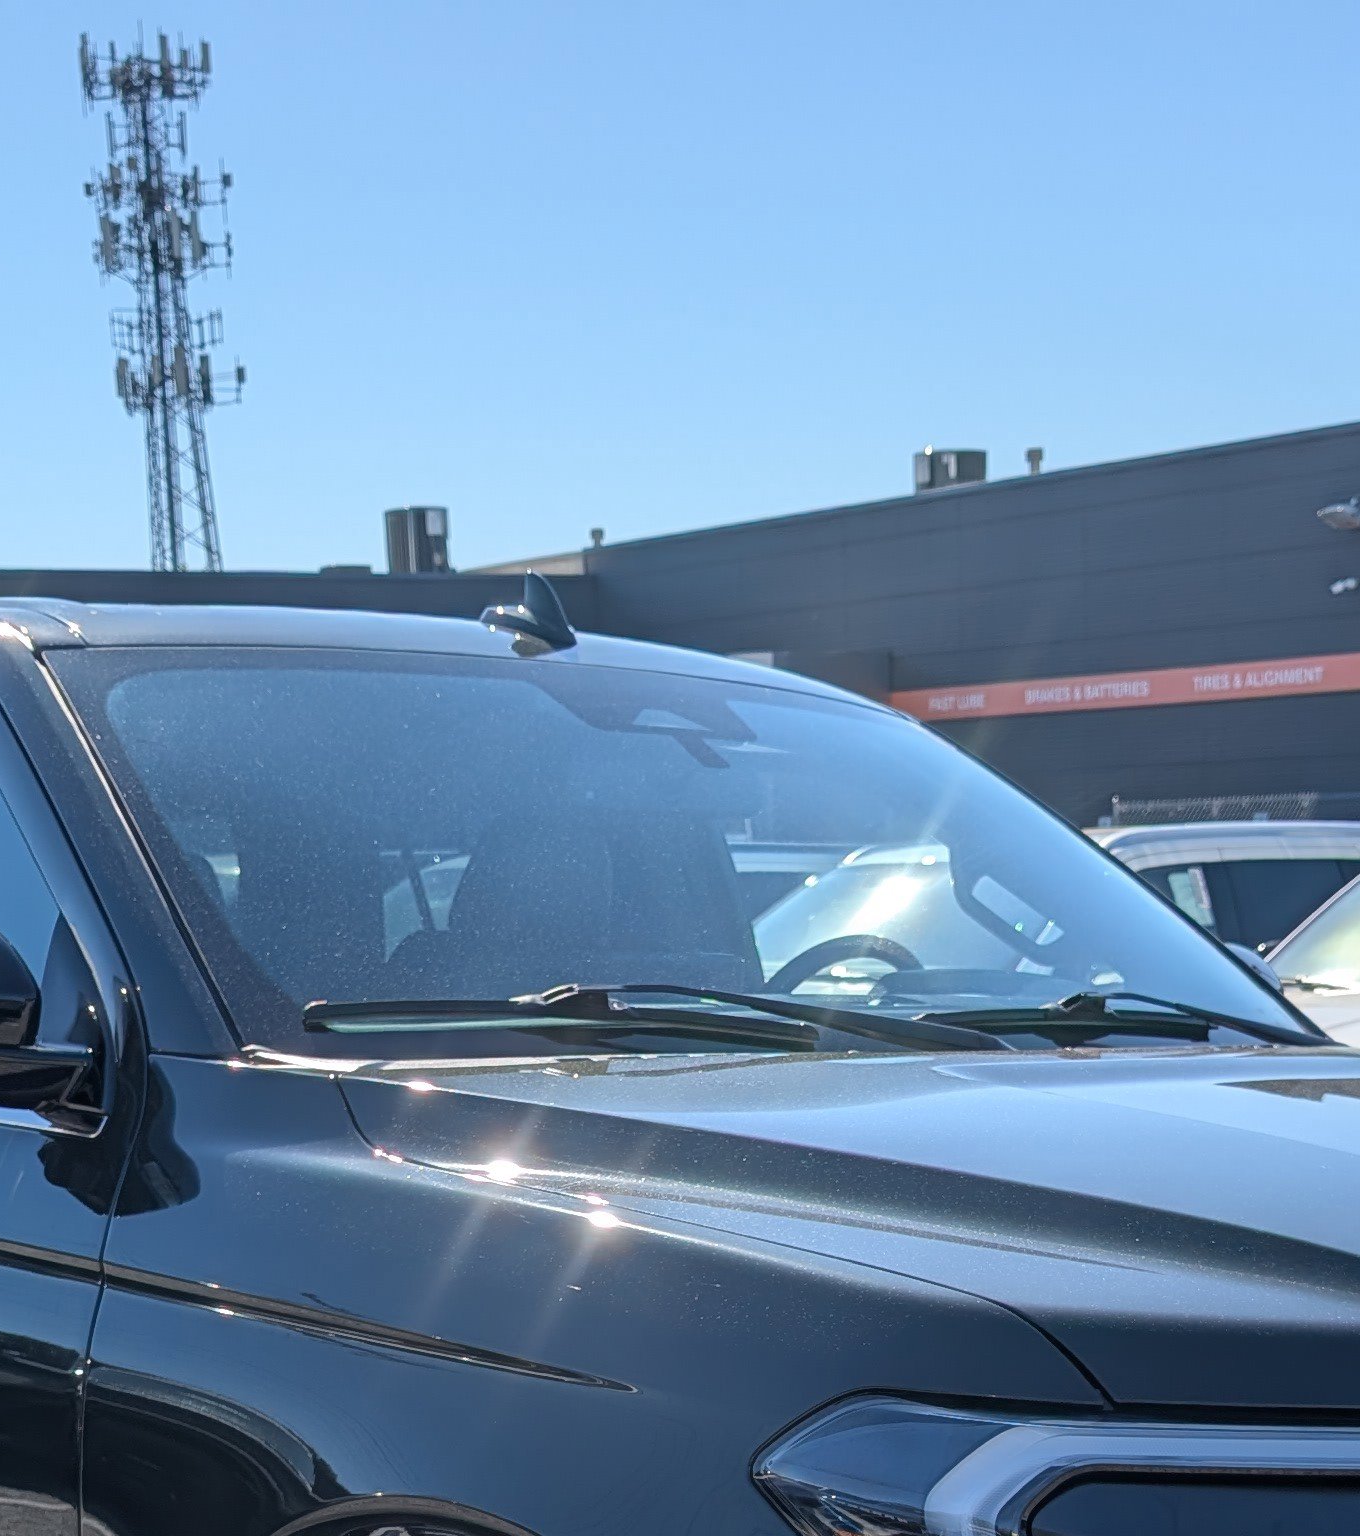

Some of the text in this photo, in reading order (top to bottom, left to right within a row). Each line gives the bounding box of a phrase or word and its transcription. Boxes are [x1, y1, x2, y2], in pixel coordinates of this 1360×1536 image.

[1193, 672, 1230, 692] TIRES
[1244, 665, 1323, 687] ALIGNMENT
[1024, 687, 1070, 705] BRAKES
[1084, 680, 1150, 700] BATTERIES
